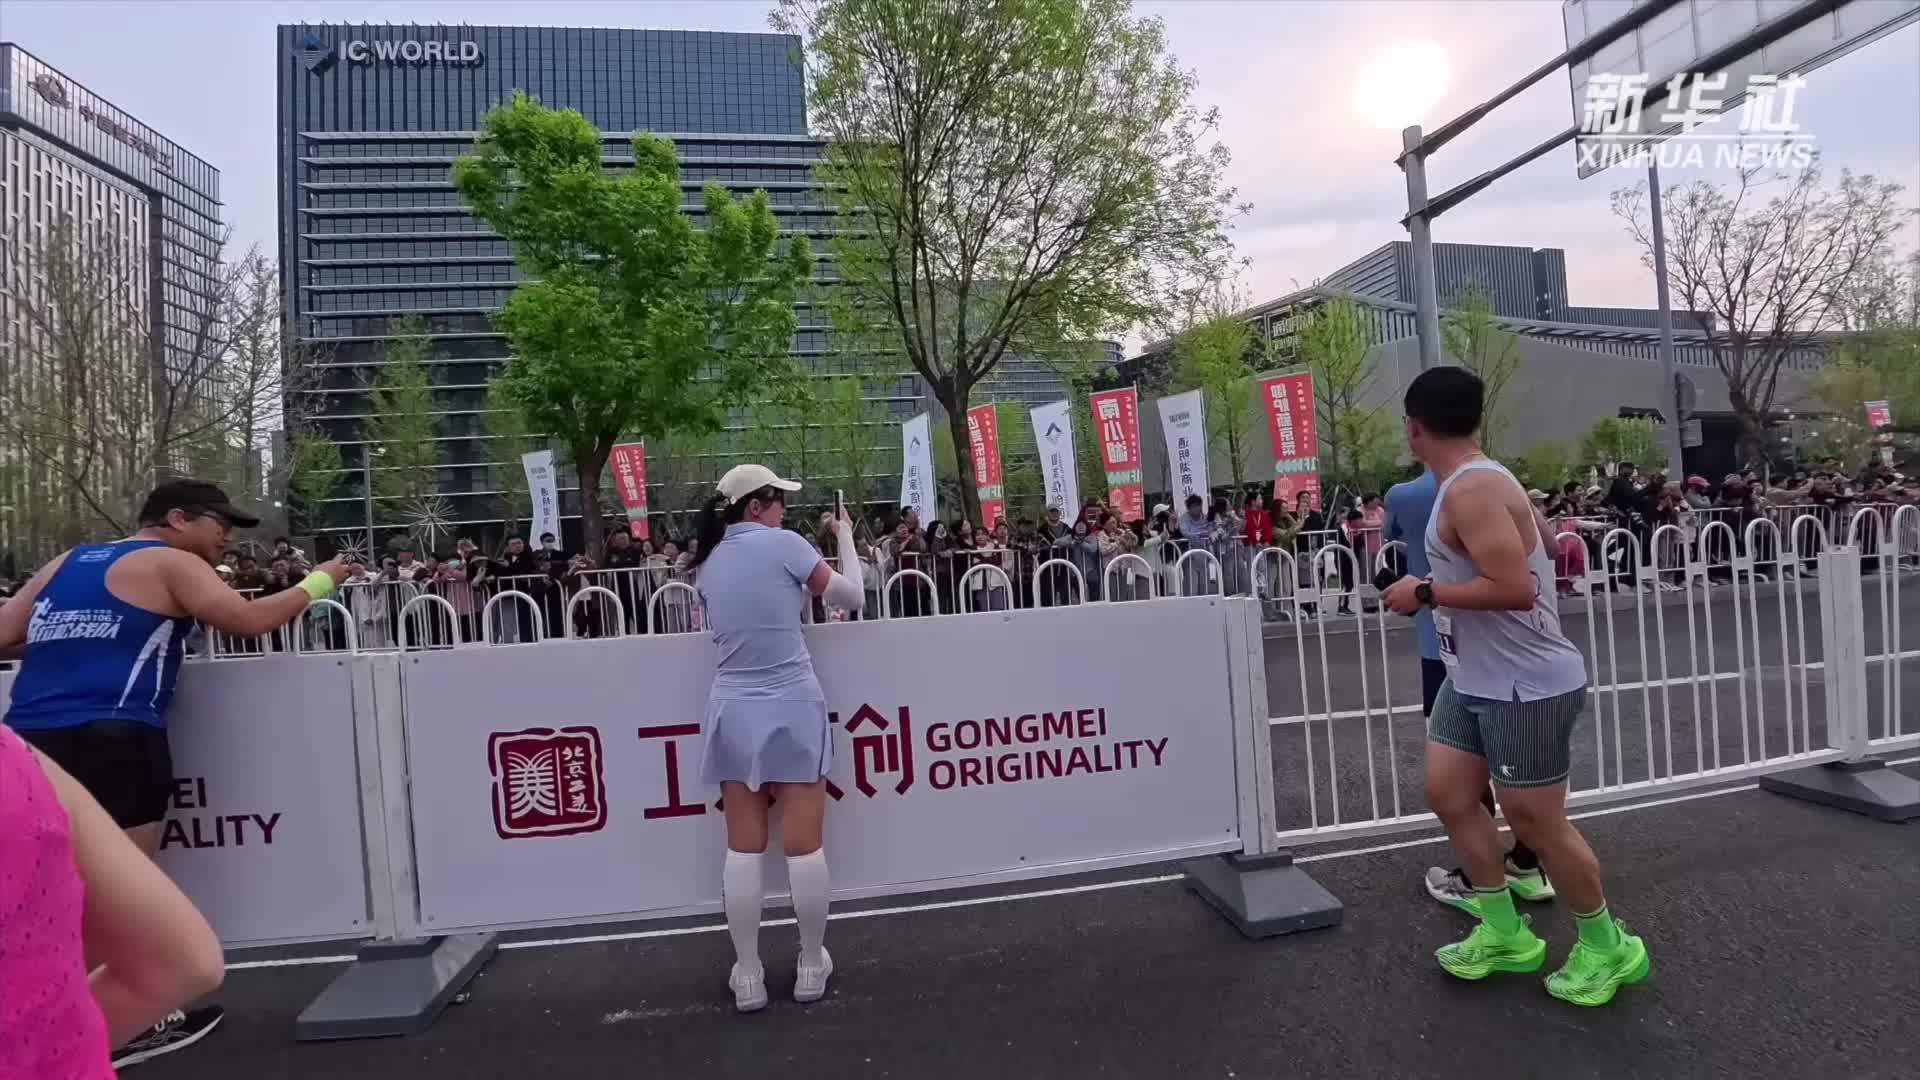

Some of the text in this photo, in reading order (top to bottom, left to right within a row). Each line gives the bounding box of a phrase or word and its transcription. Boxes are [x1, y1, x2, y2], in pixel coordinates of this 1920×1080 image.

[340, 40, 479, 61] IC WORLD
[926, 707, 1107, 753] GONGMEI
[638, 703, 914, 819] 工创
[928, 737, 1169, 791] ORIGINALITY
